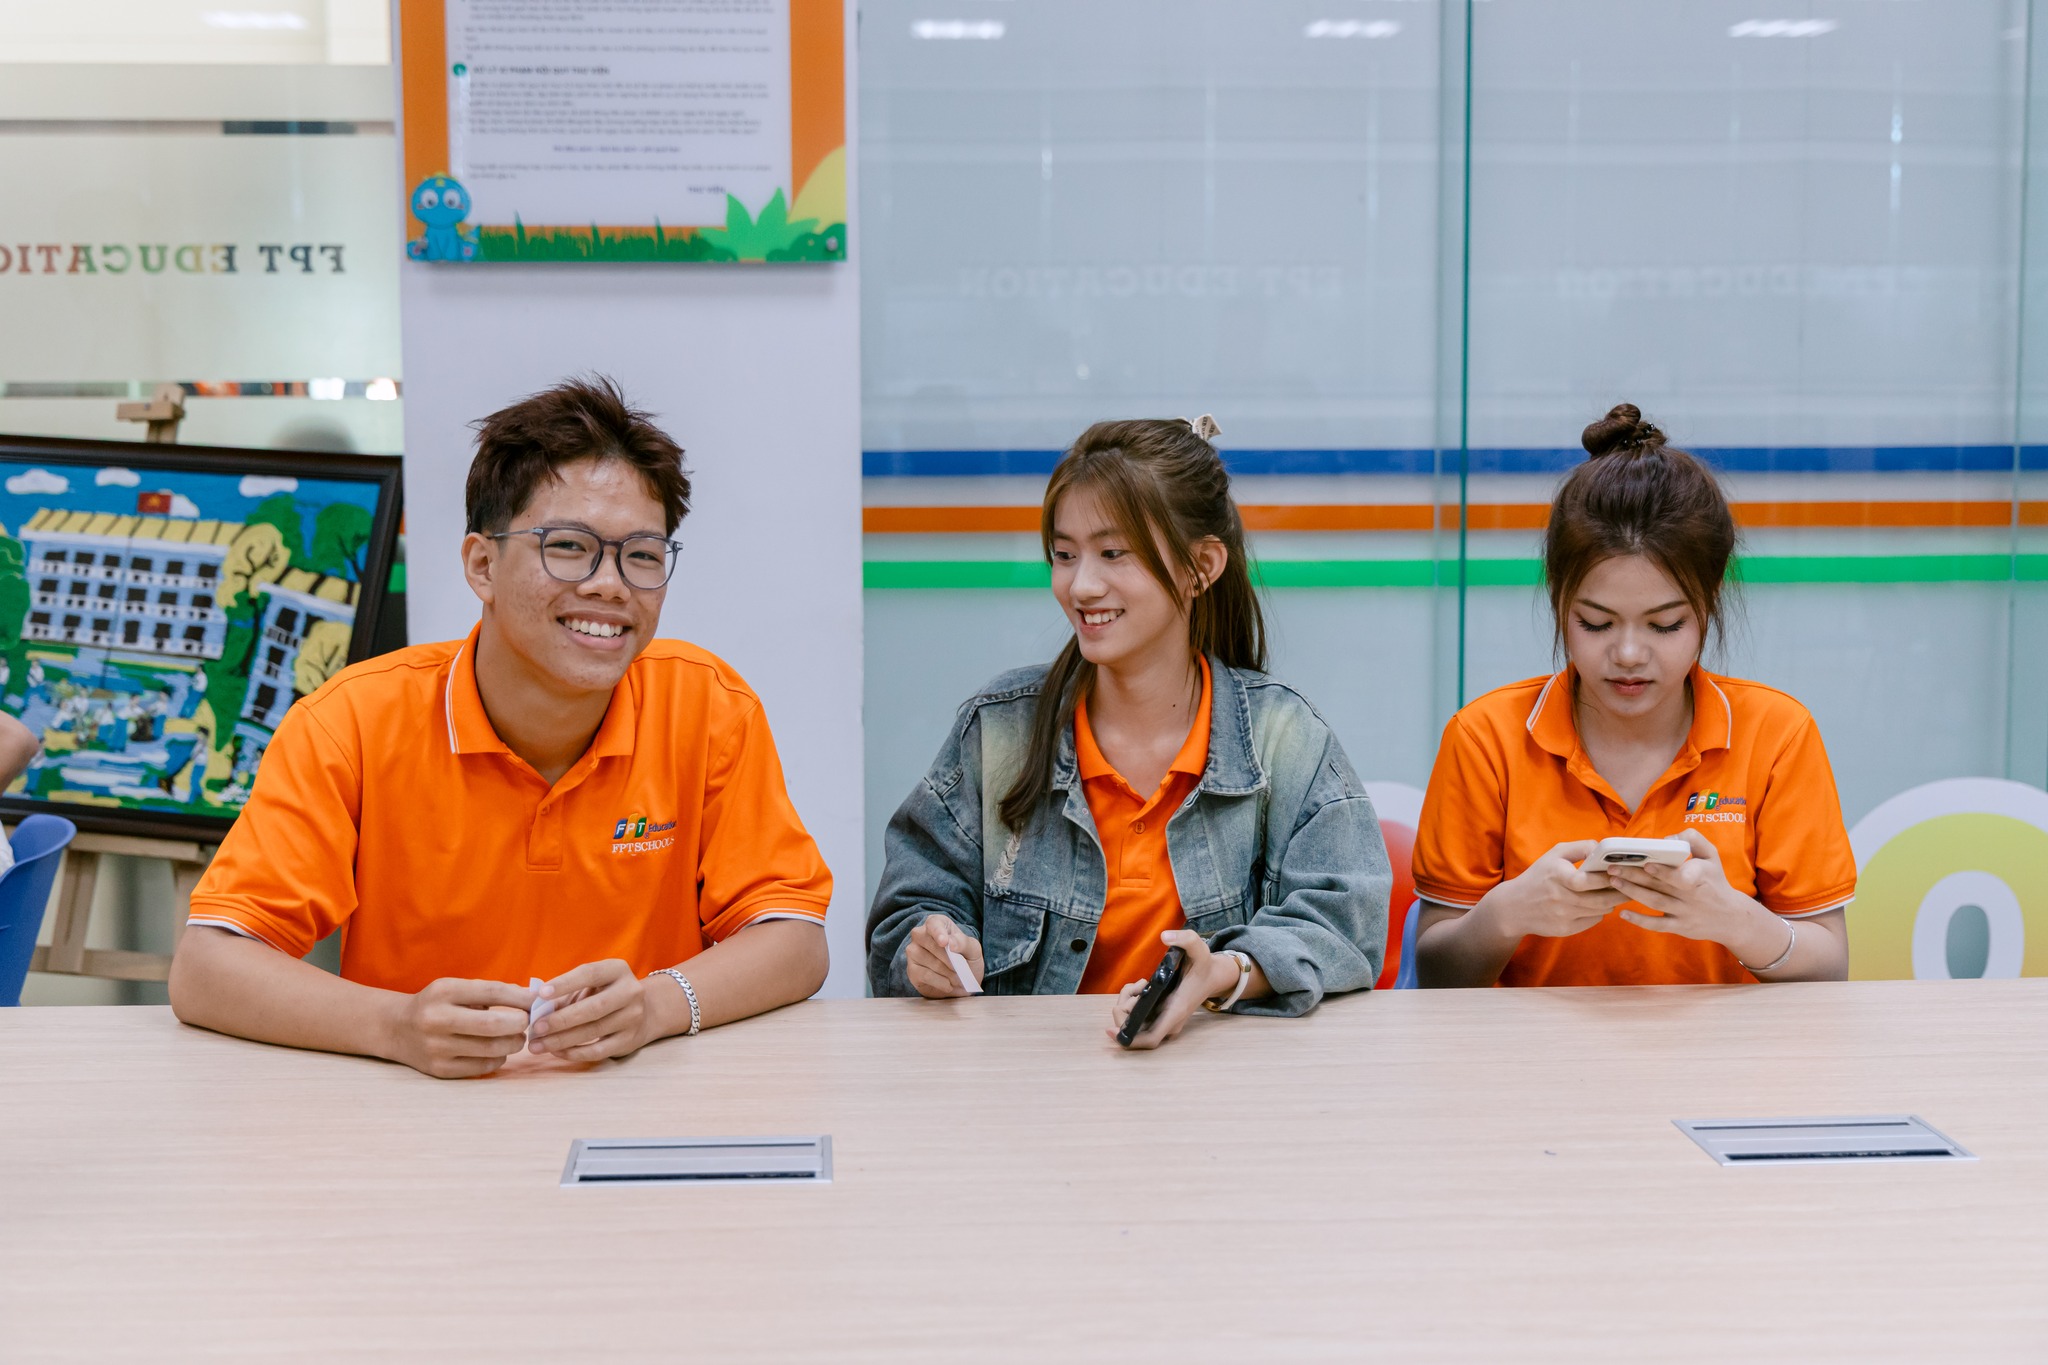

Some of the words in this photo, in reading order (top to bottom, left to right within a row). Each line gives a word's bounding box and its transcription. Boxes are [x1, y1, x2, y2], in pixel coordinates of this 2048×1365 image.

[1687, 794, 1718, 808] FPT
[1705, 813, 1746, 823] SCHOOL
[615, 820, 646, 836] FPT
